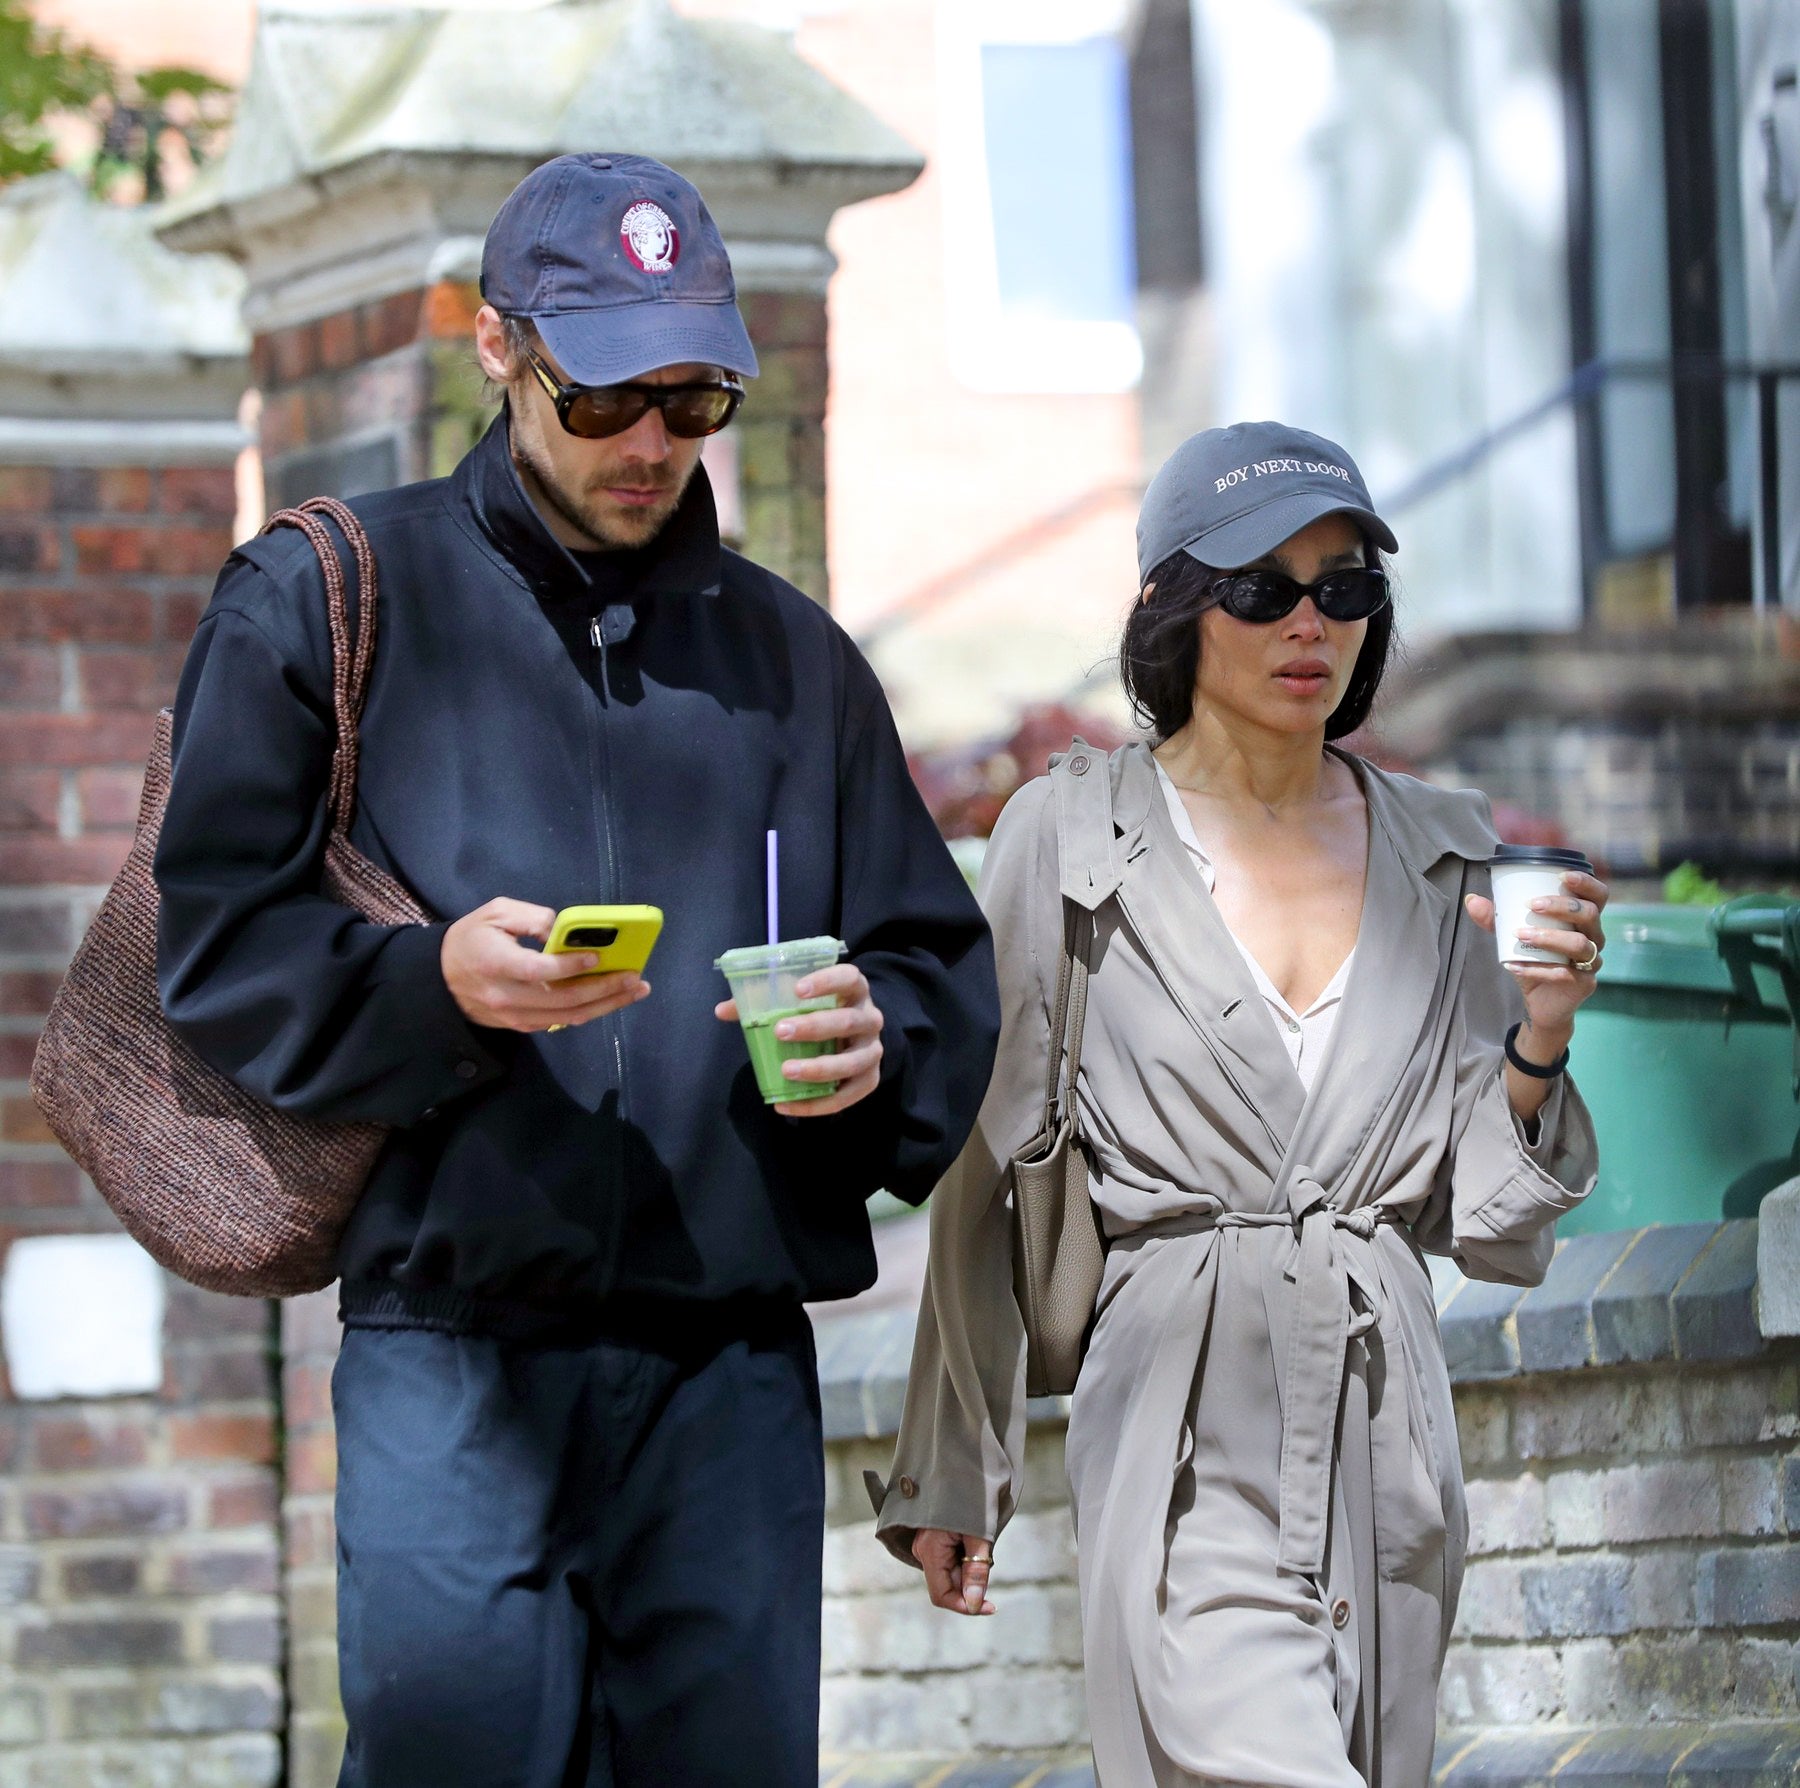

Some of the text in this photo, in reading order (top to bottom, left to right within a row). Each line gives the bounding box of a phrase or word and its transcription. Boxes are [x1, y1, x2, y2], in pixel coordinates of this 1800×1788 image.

[620, 207, 638, 234] COURT
[1214, 459, 1351, 493] BOY NEXT DOOR
